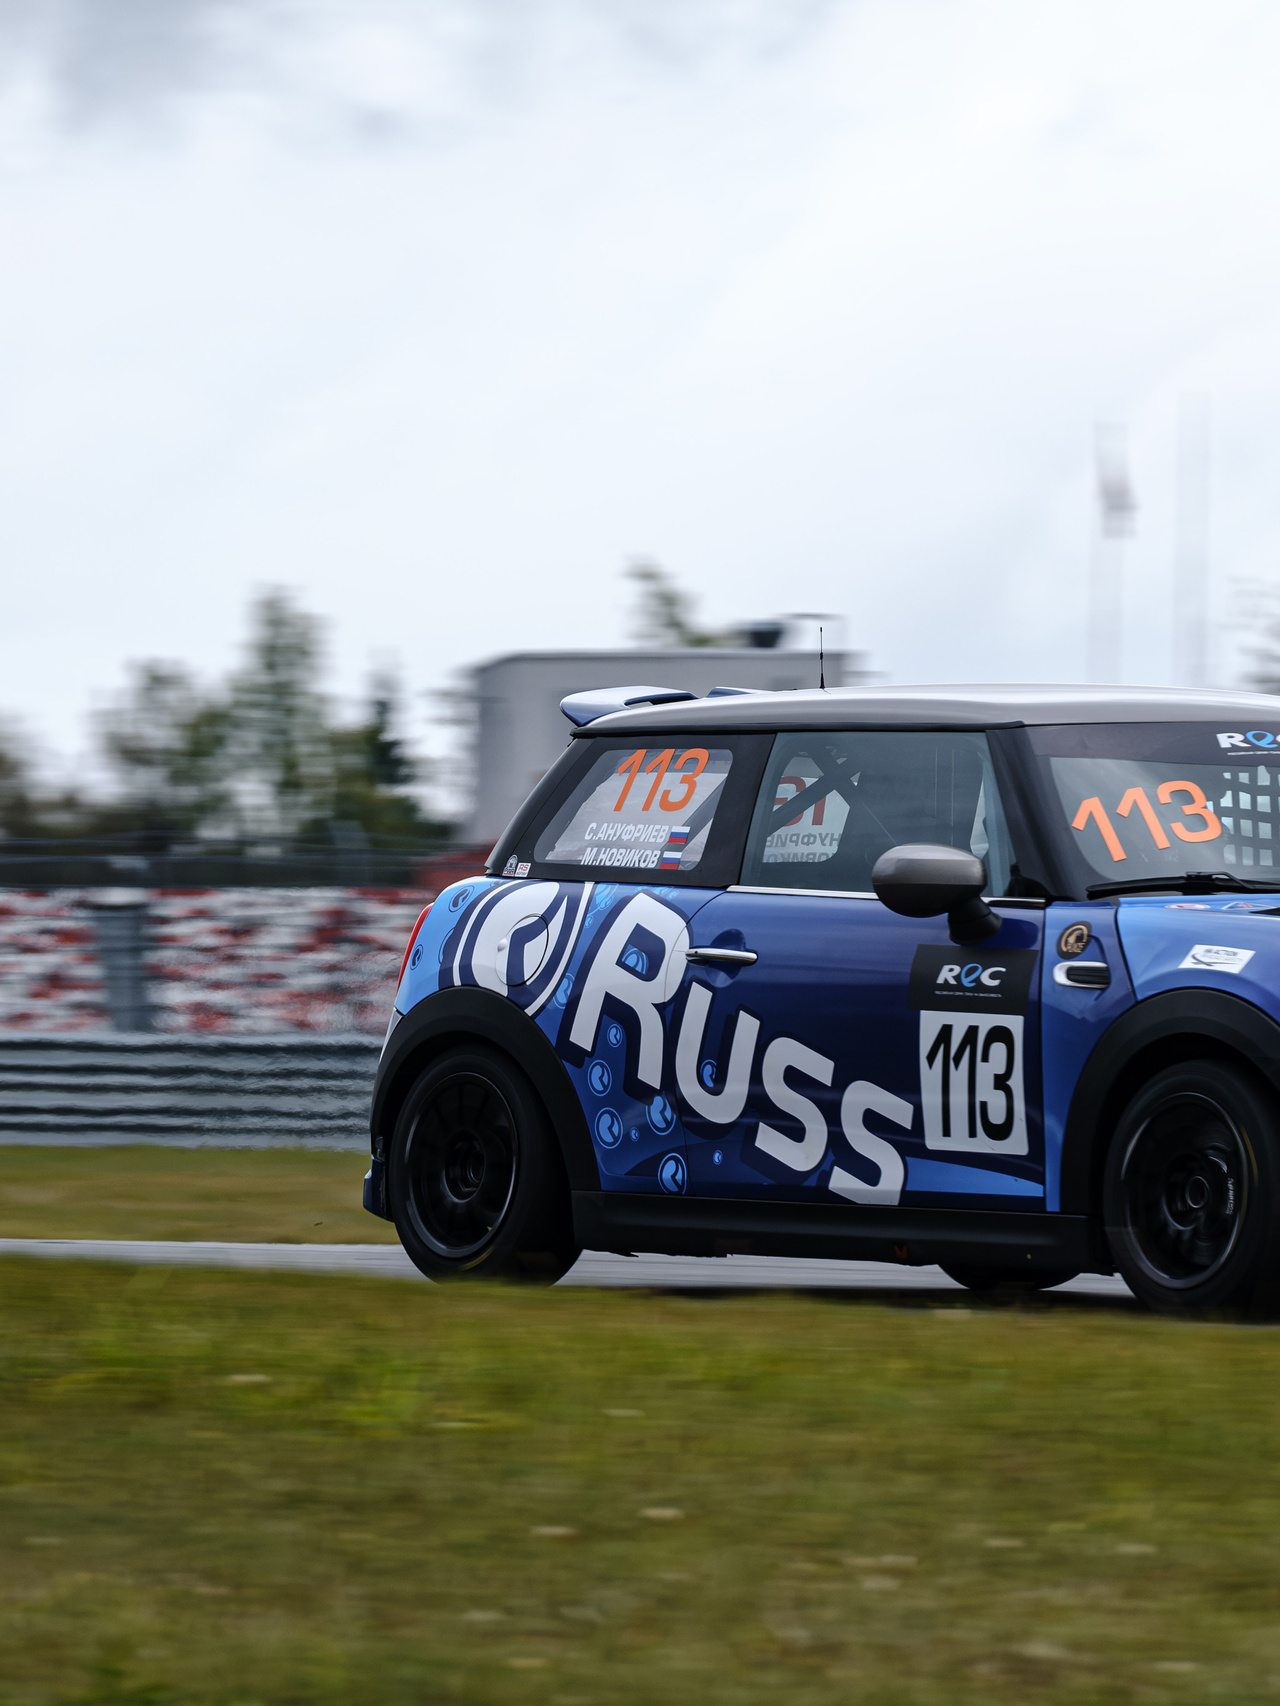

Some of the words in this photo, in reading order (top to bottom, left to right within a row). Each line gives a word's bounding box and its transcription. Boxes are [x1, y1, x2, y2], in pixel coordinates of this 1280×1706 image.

[613, 748, 710, 812] 113
[584, 822, 669, 843] С.АНУФРИЕВ
[1071, 780, 1222, 862] 113
[580, 847, 661, 868] М.НОВИКОВ
[926, 1023, 1015, 1142] 113
